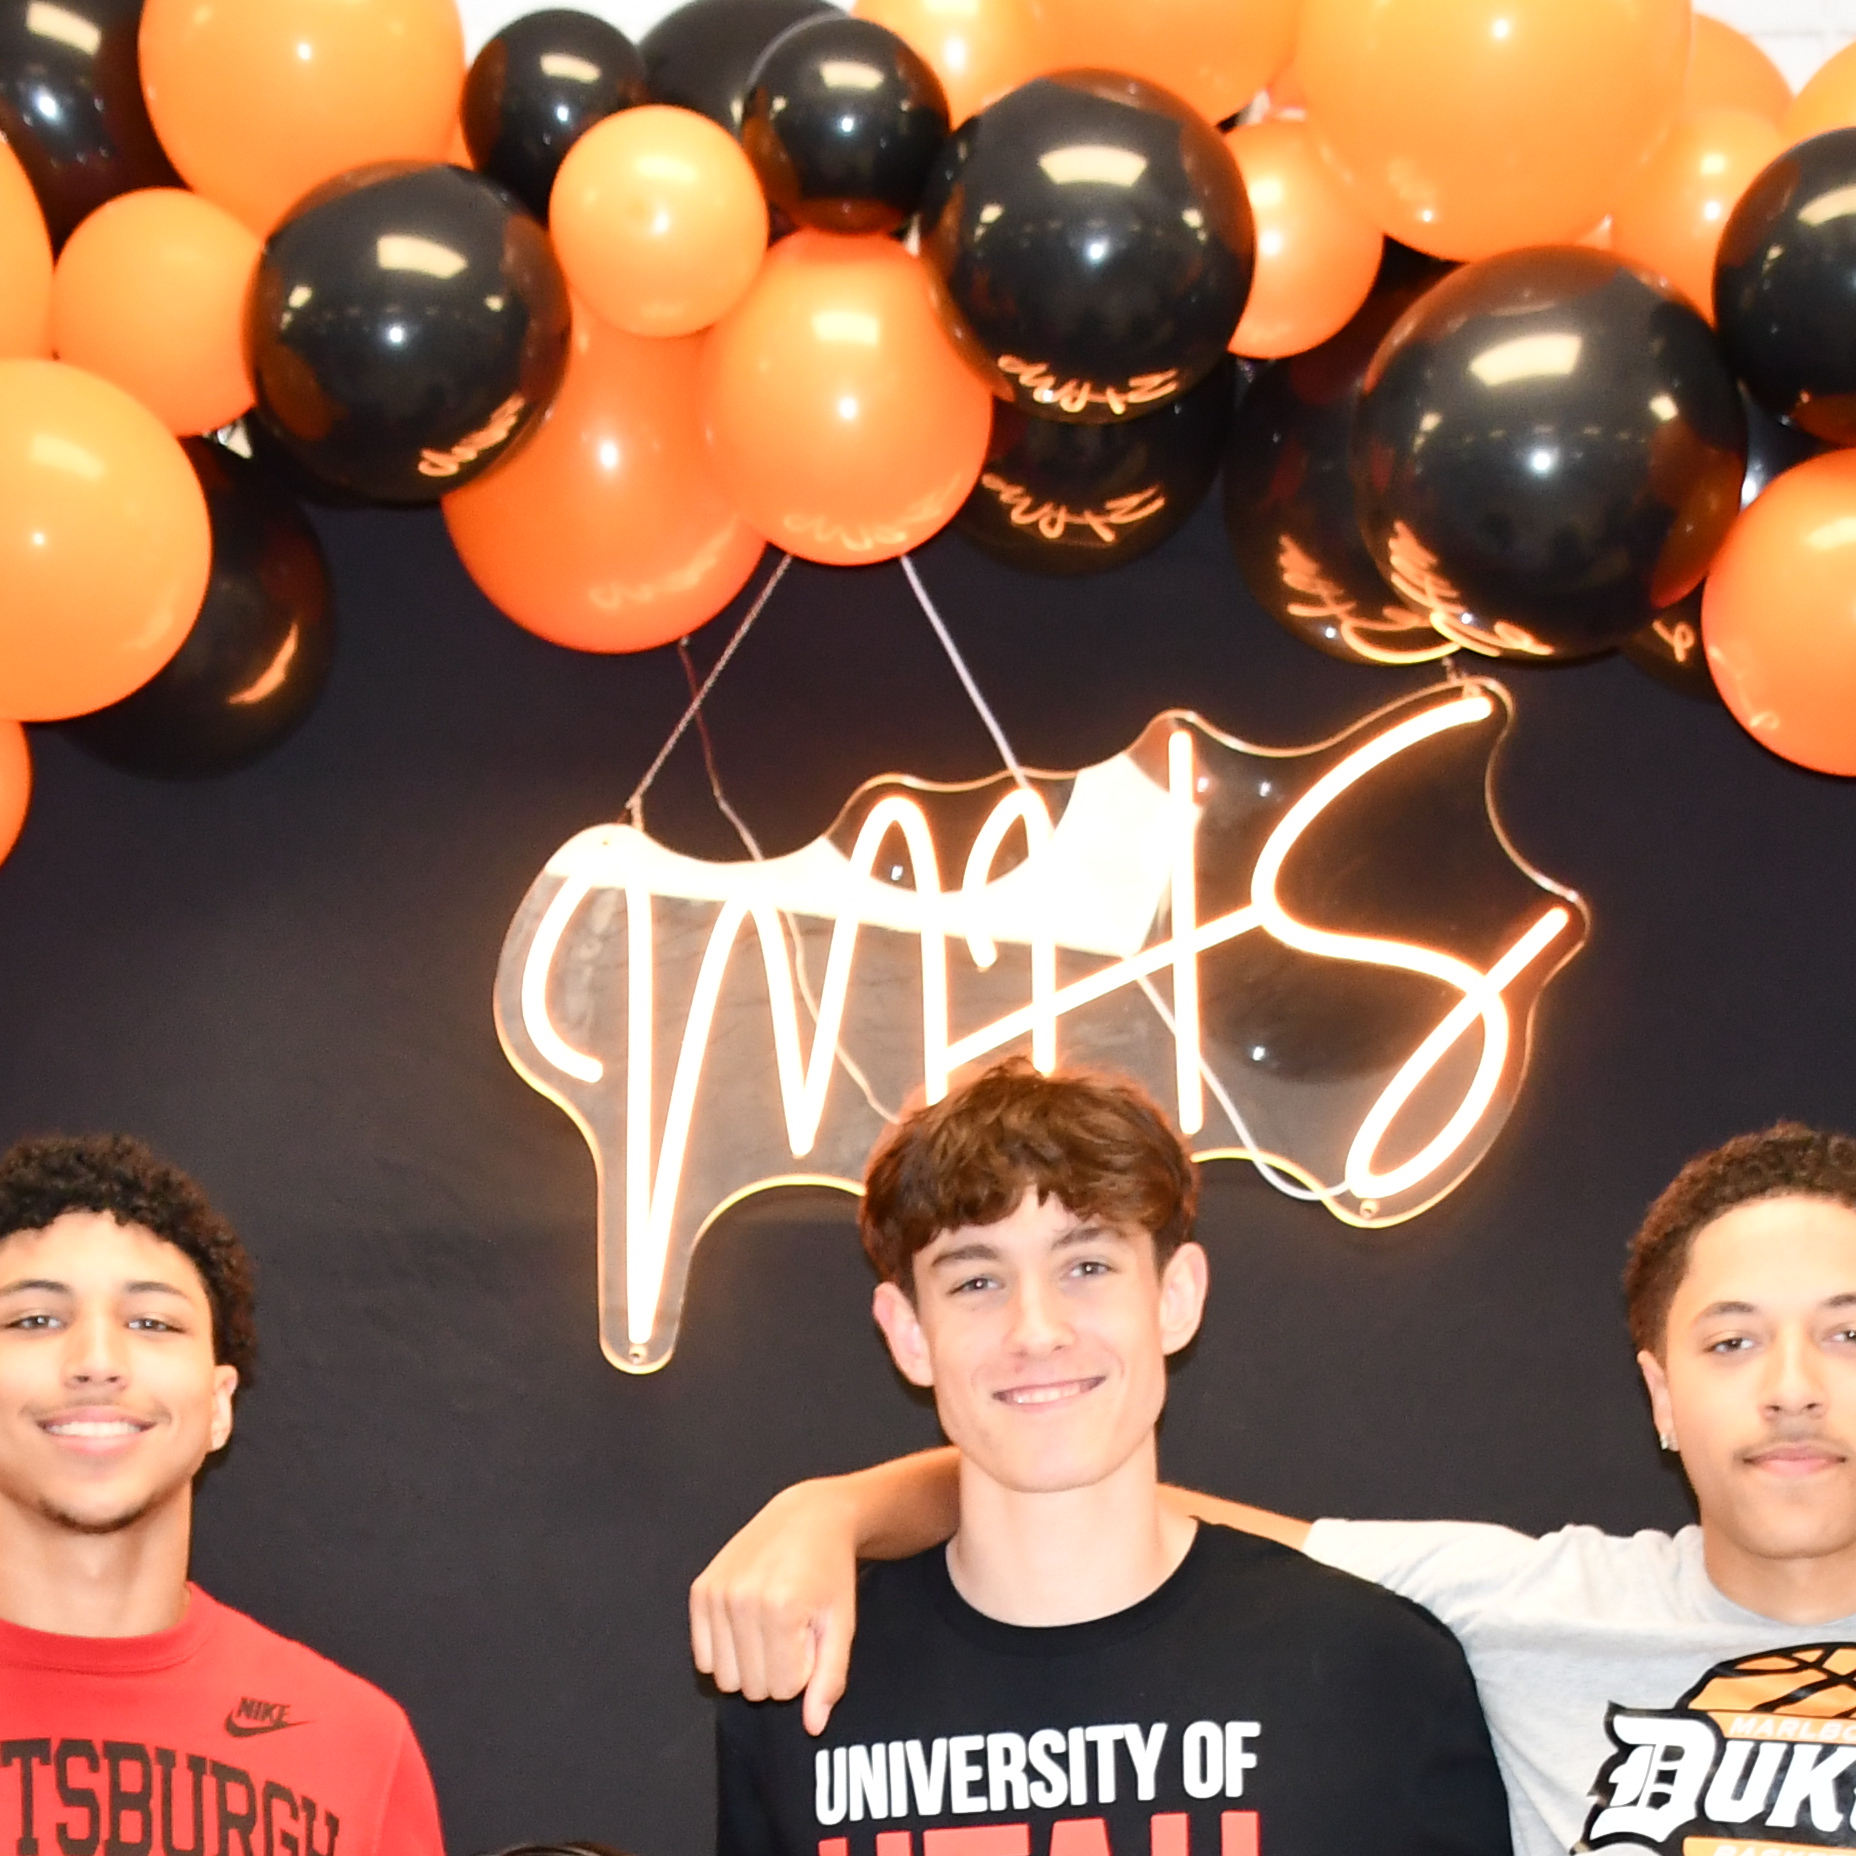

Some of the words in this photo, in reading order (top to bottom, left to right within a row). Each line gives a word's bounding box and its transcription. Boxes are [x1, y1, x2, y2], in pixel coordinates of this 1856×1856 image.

[235, 1696, 292, 1725] NIKE
[814, 1722, 1168, 1826] UNIVERSITY
[1181, 1719, 1262, 1799] OF
